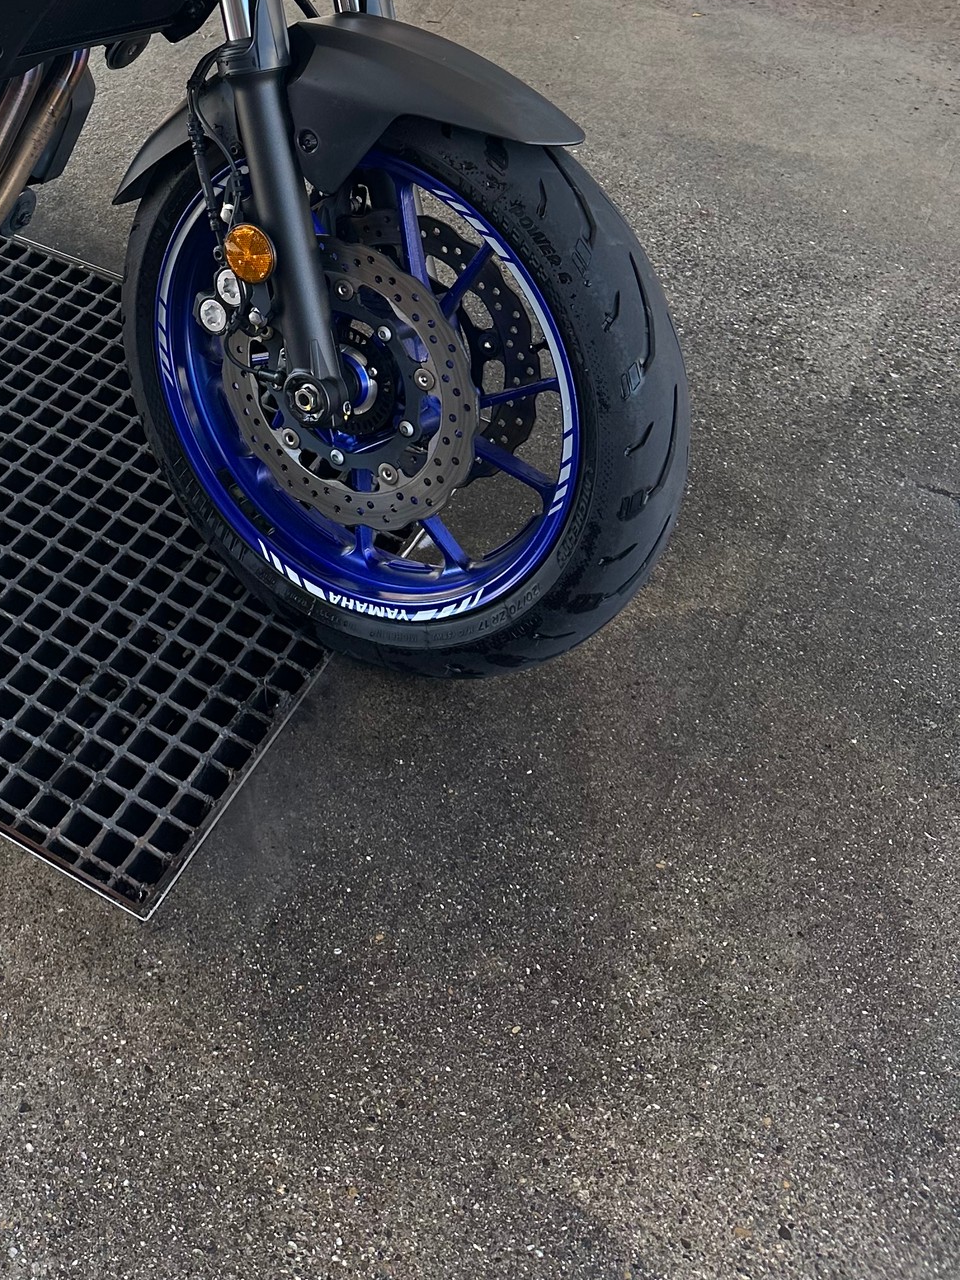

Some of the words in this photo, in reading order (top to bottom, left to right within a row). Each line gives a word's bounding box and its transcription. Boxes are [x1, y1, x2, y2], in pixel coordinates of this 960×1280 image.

[329, 591, 409, 622] YAMAHA
[491, 610, 506, 623] ZR
[478, 620, 489, 631] 17
